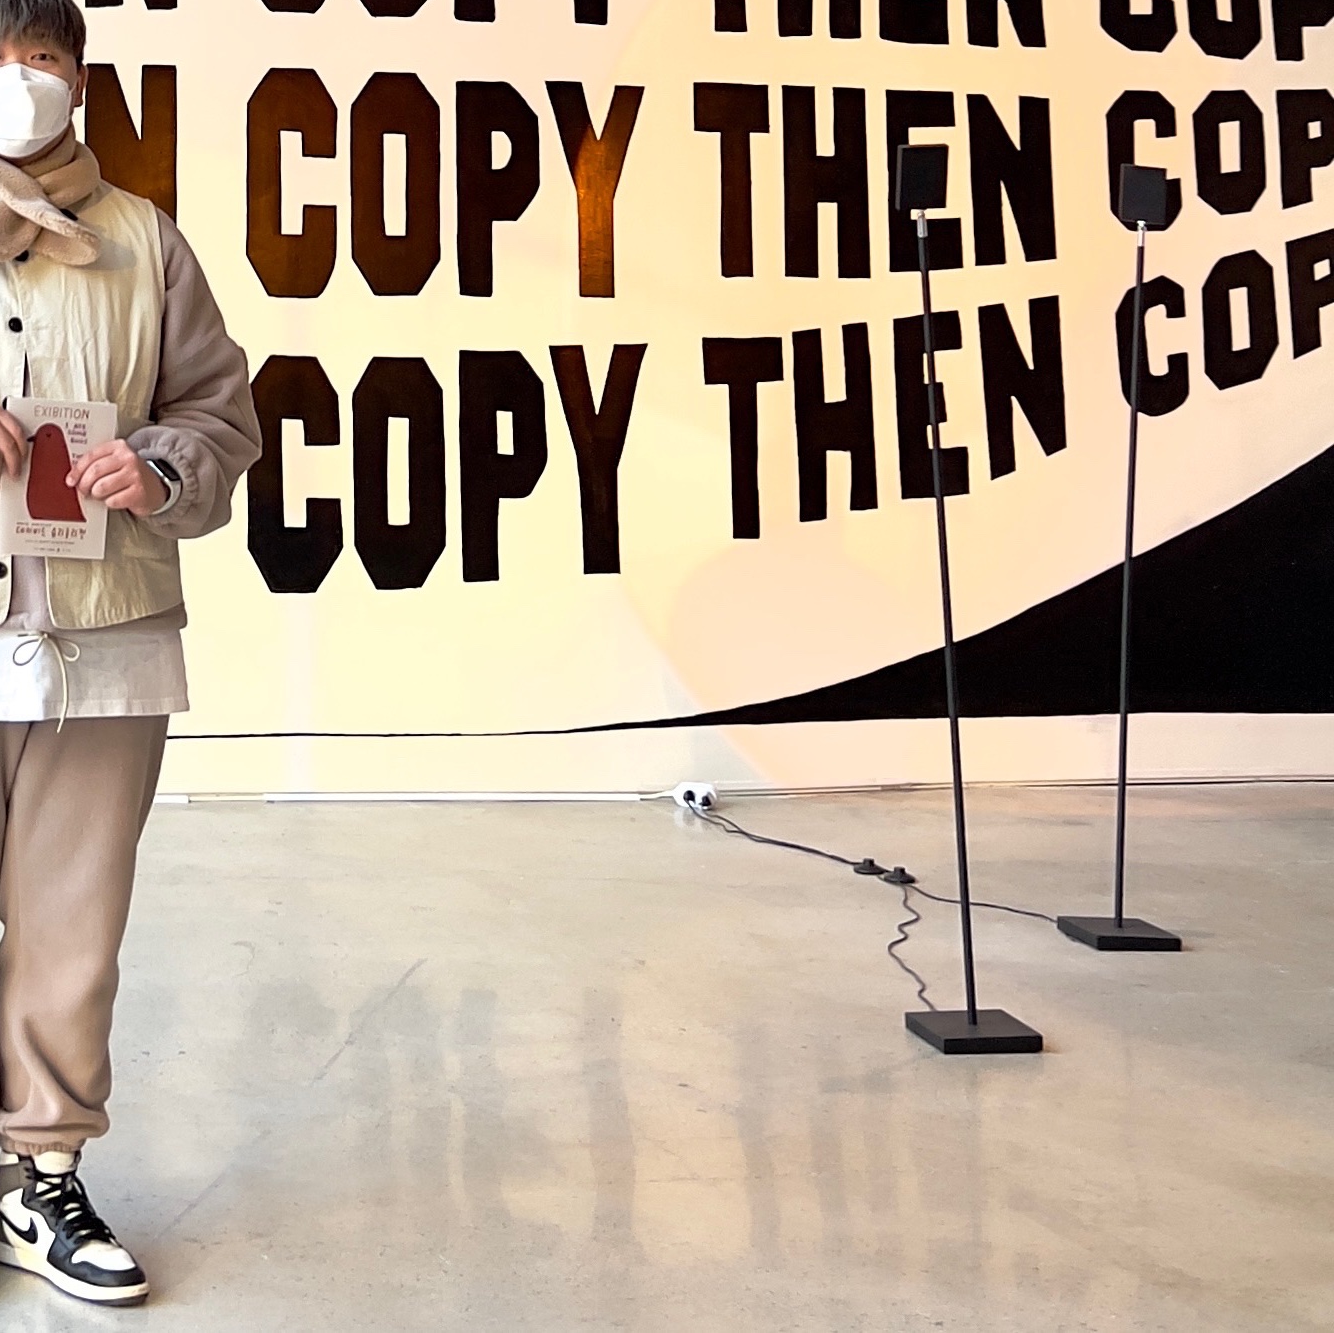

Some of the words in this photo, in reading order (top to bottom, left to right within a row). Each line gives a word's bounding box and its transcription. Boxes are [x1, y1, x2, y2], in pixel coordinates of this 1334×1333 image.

[246, 68, 645, 298] COPY
[694, 82, 1056, 279] THEN
[34, 404, 90, 419] EXIBITION
[246, 344, 648, 593] COPY
[702, 295, 1066, 540] THEN
